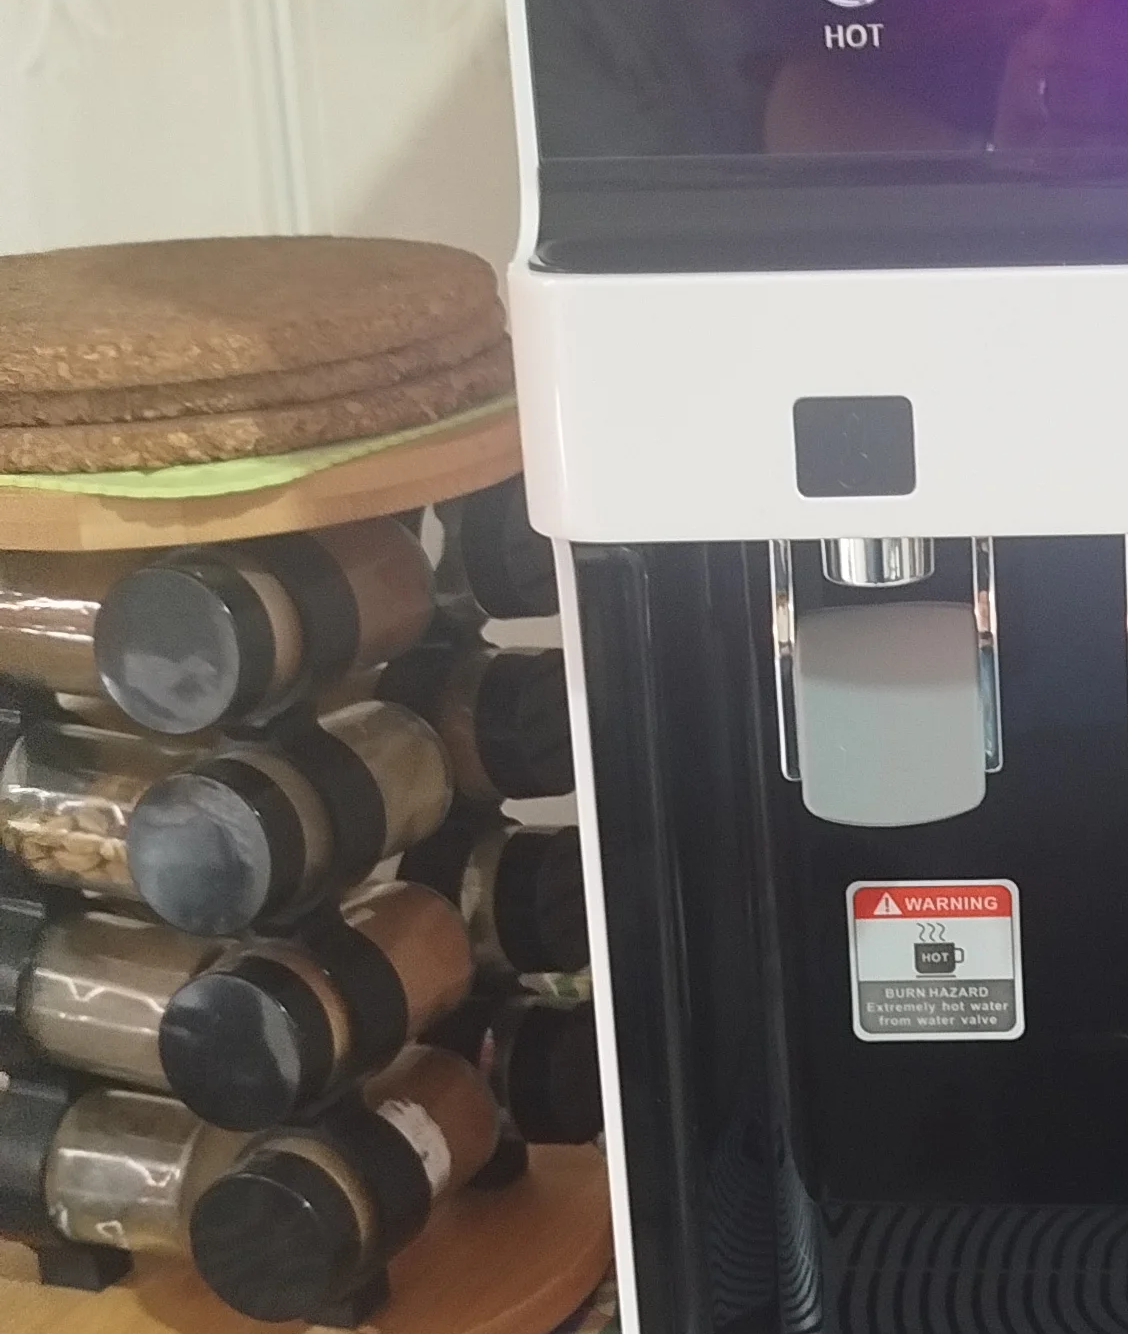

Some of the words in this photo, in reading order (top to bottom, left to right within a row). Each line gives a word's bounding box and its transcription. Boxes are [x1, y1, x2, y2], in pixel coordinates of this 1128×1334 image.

[823, 22, 884, 50] HOT
[904, 896, 999, 912] WARNING
[921, 952, 949, 963] HOT
[885, 987, 926, 999] BURN
[929, 986, 989, 998] HAZARD
[866, 1002, 936, 1014] Extremely
[942, 1001, 965, 1012] hot
[971, 1001, 1009, 1012] water
[879, 1015, 911, 1026] from
[917, 1015, 955, 1026] water
[962, 1014, 998, 1025] valve
